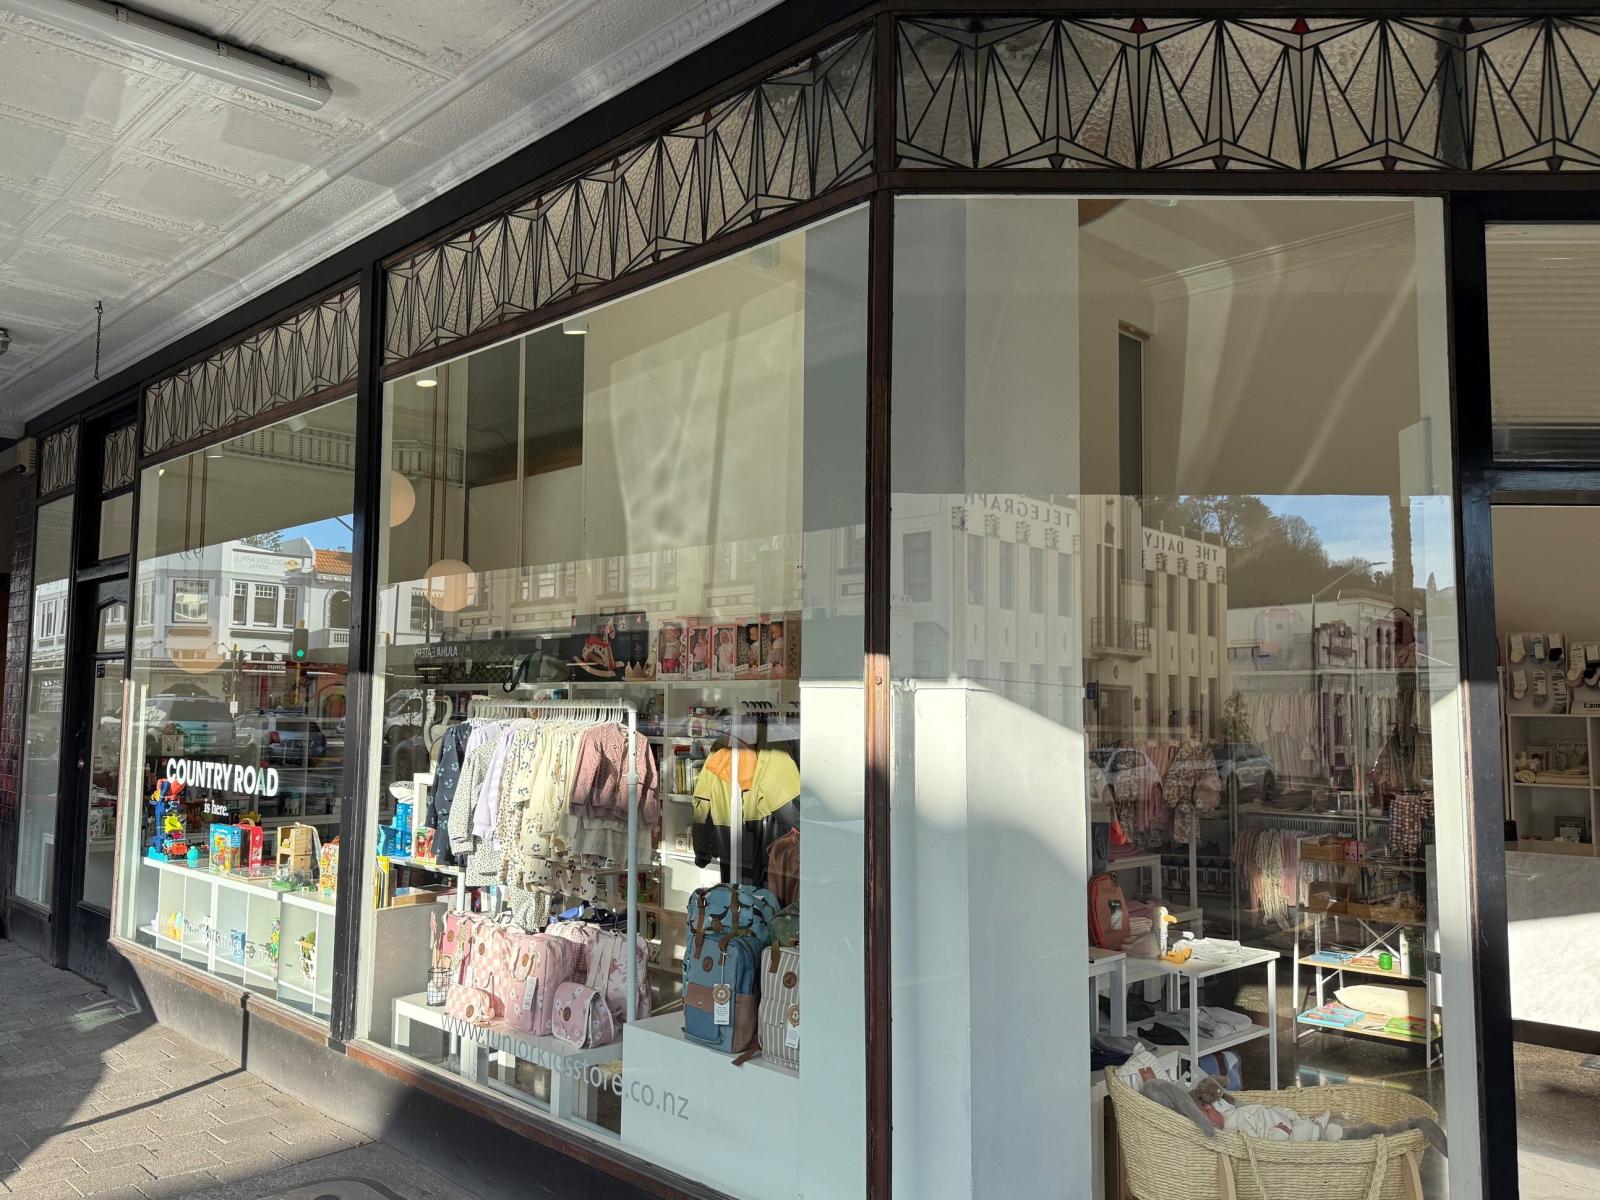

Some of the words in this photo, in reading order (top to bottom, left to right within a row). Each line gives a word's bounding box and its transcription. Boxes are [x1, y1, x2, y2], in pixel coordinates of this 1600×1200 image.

[166, 757, 233, 791] COUNTRY
[233, 764, 279, 797] ROAD
[203, 799, 212, 814] is
[212, 799, 229, 817] here.
